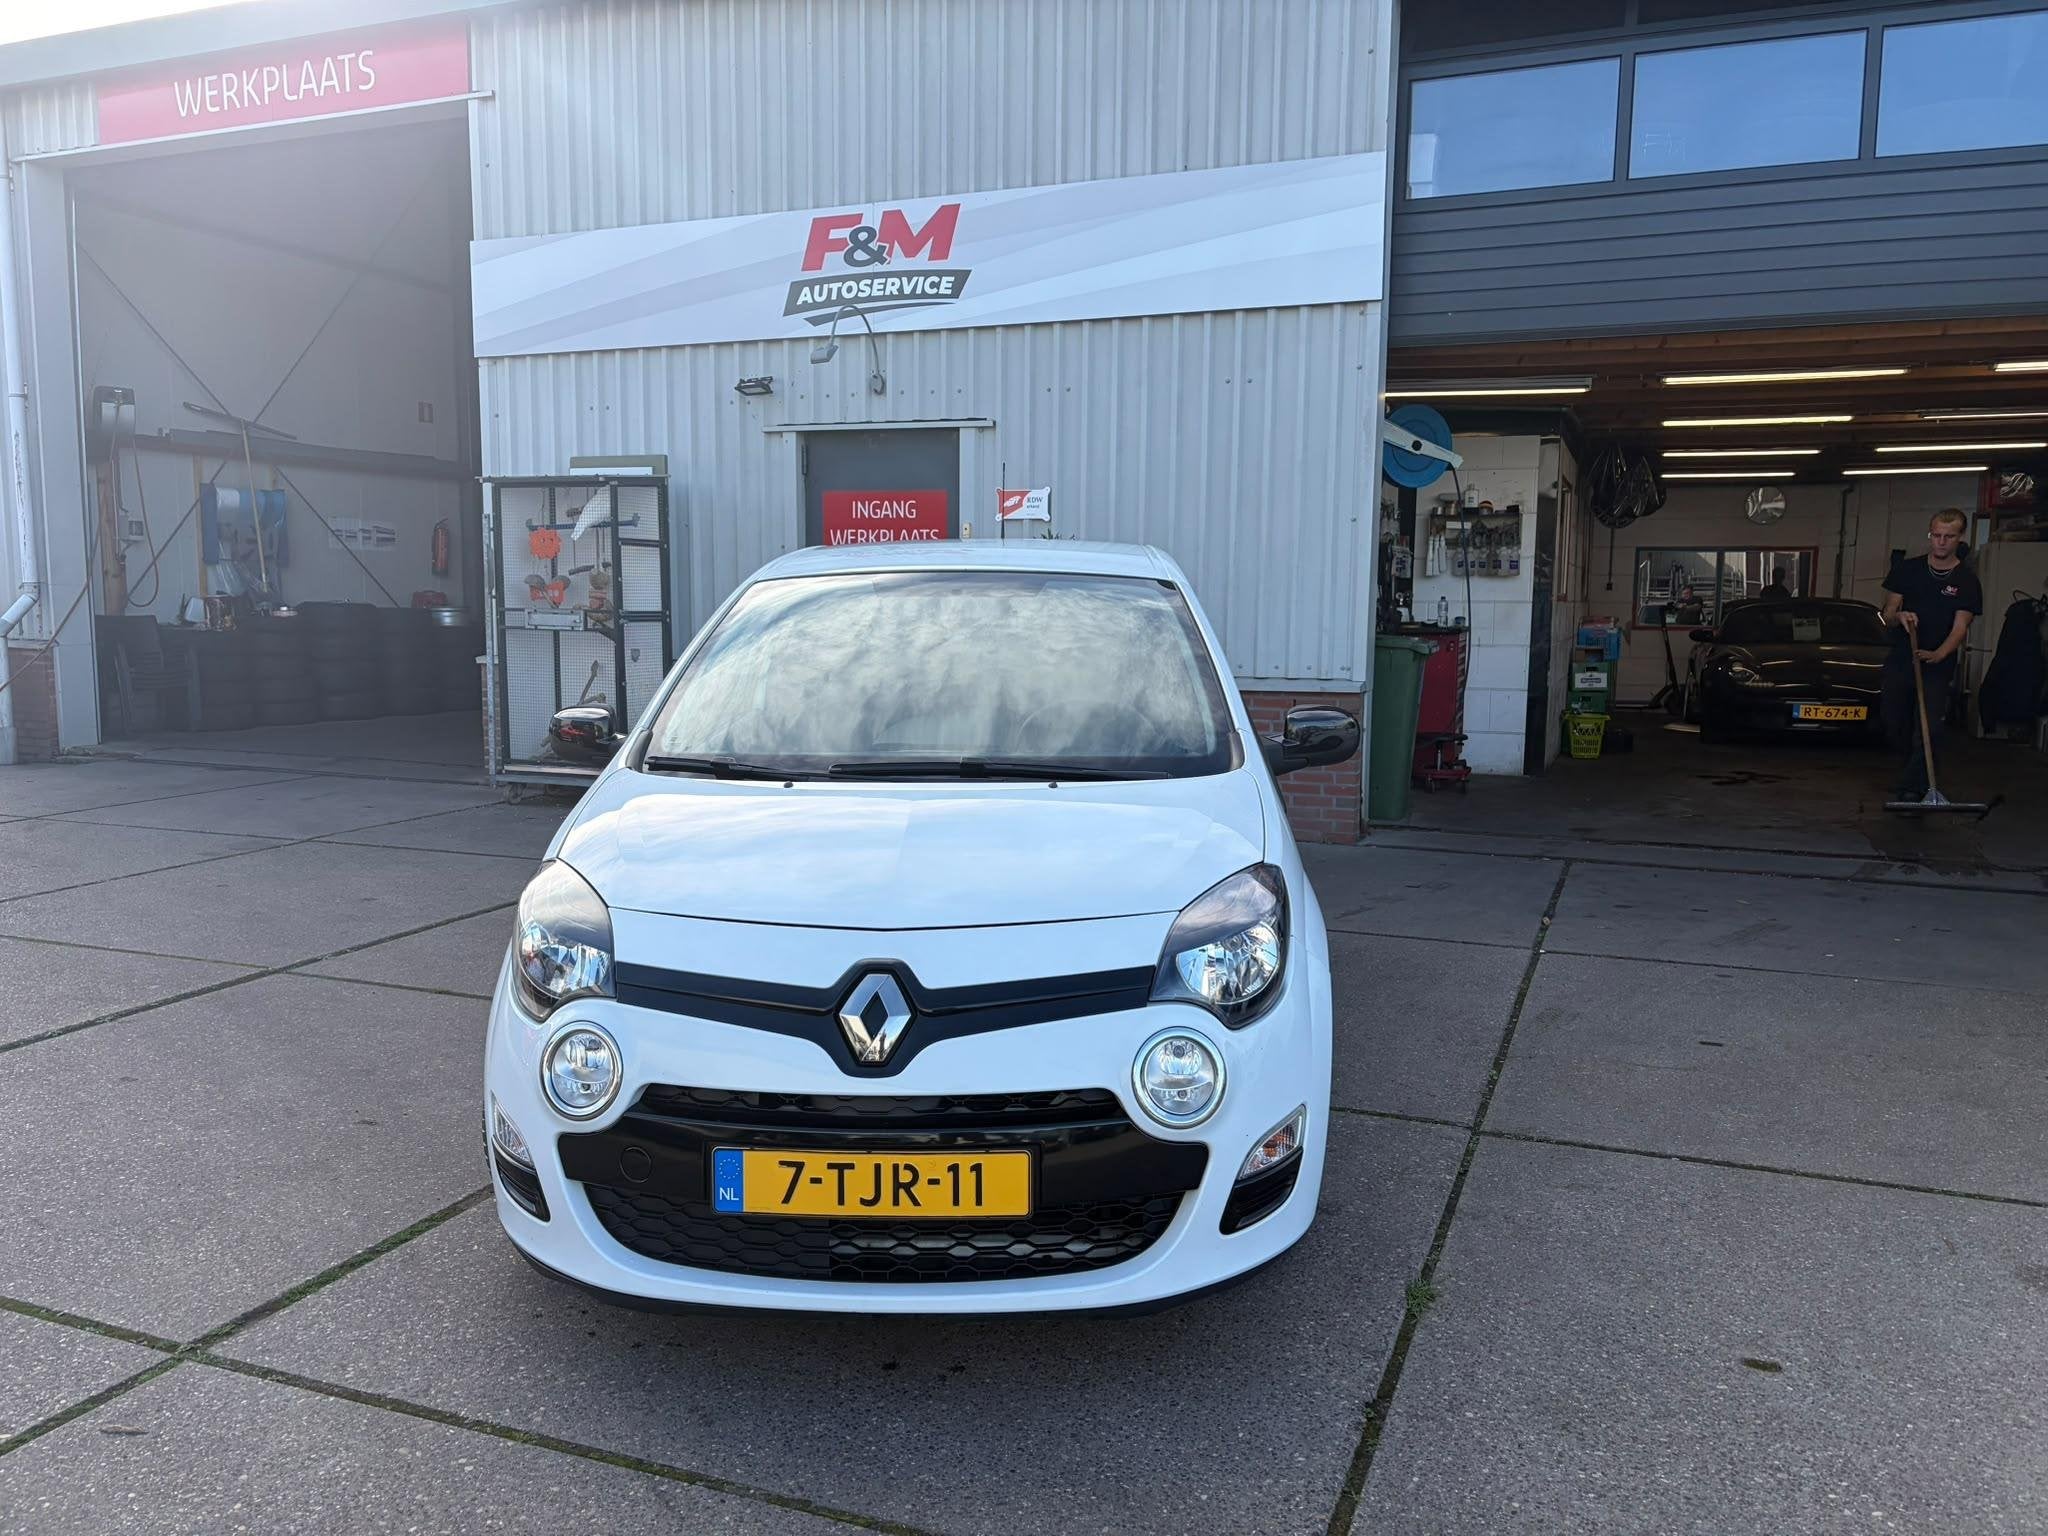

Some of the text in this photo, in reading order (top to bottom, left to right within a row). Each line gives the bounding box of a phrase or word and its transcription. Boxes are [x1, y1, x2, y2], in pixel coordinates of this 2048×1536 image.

[174, 50, 376, 118] WERKPLAATS
[800, 202, 962, 272] F&M
[796, 275, 955, 305] AUTOSERVICE
[851, 500, 917, 519] INGANG
[1803, 707, 1861, 719] RT-674-K
[718, 1187, 740, 1202] NL
[777, 1159, 983, 1207] 7-TJR-11
